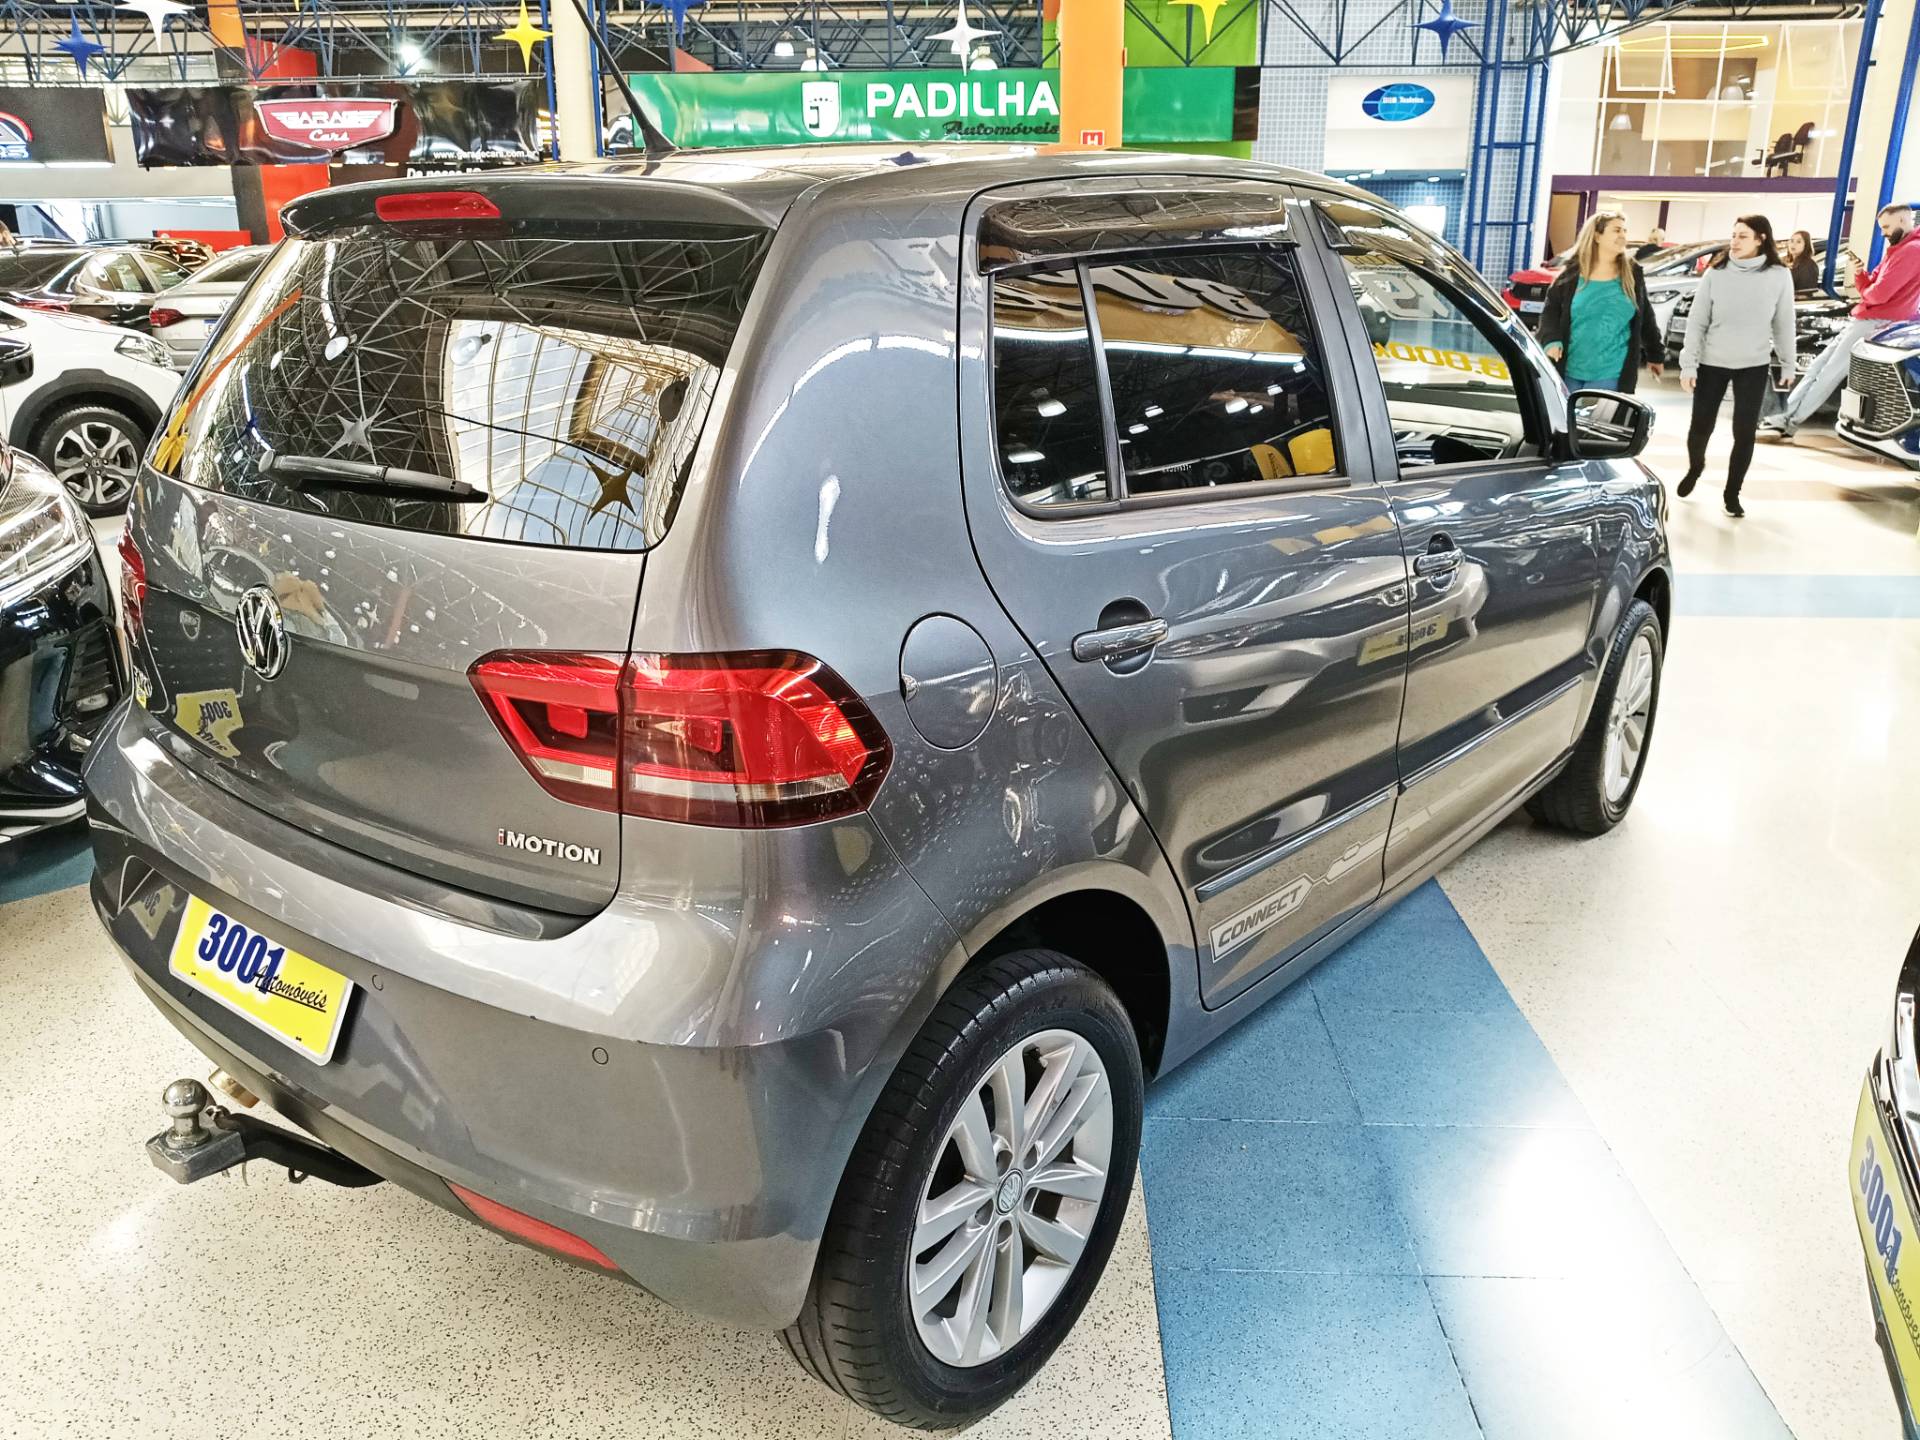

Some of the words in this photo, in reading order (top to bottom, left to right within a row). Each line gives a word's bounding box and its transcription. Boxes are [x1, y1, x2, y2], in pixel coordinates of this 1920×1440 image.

[866, 80, 1061, 119] PADILHA
[308, 129, 350, 142] Cars
[1218, 884, 1303, 948] CONNECT
[198, 913, 285, 994] 3001
[1859, 1135, 1902, 1286] 3001
